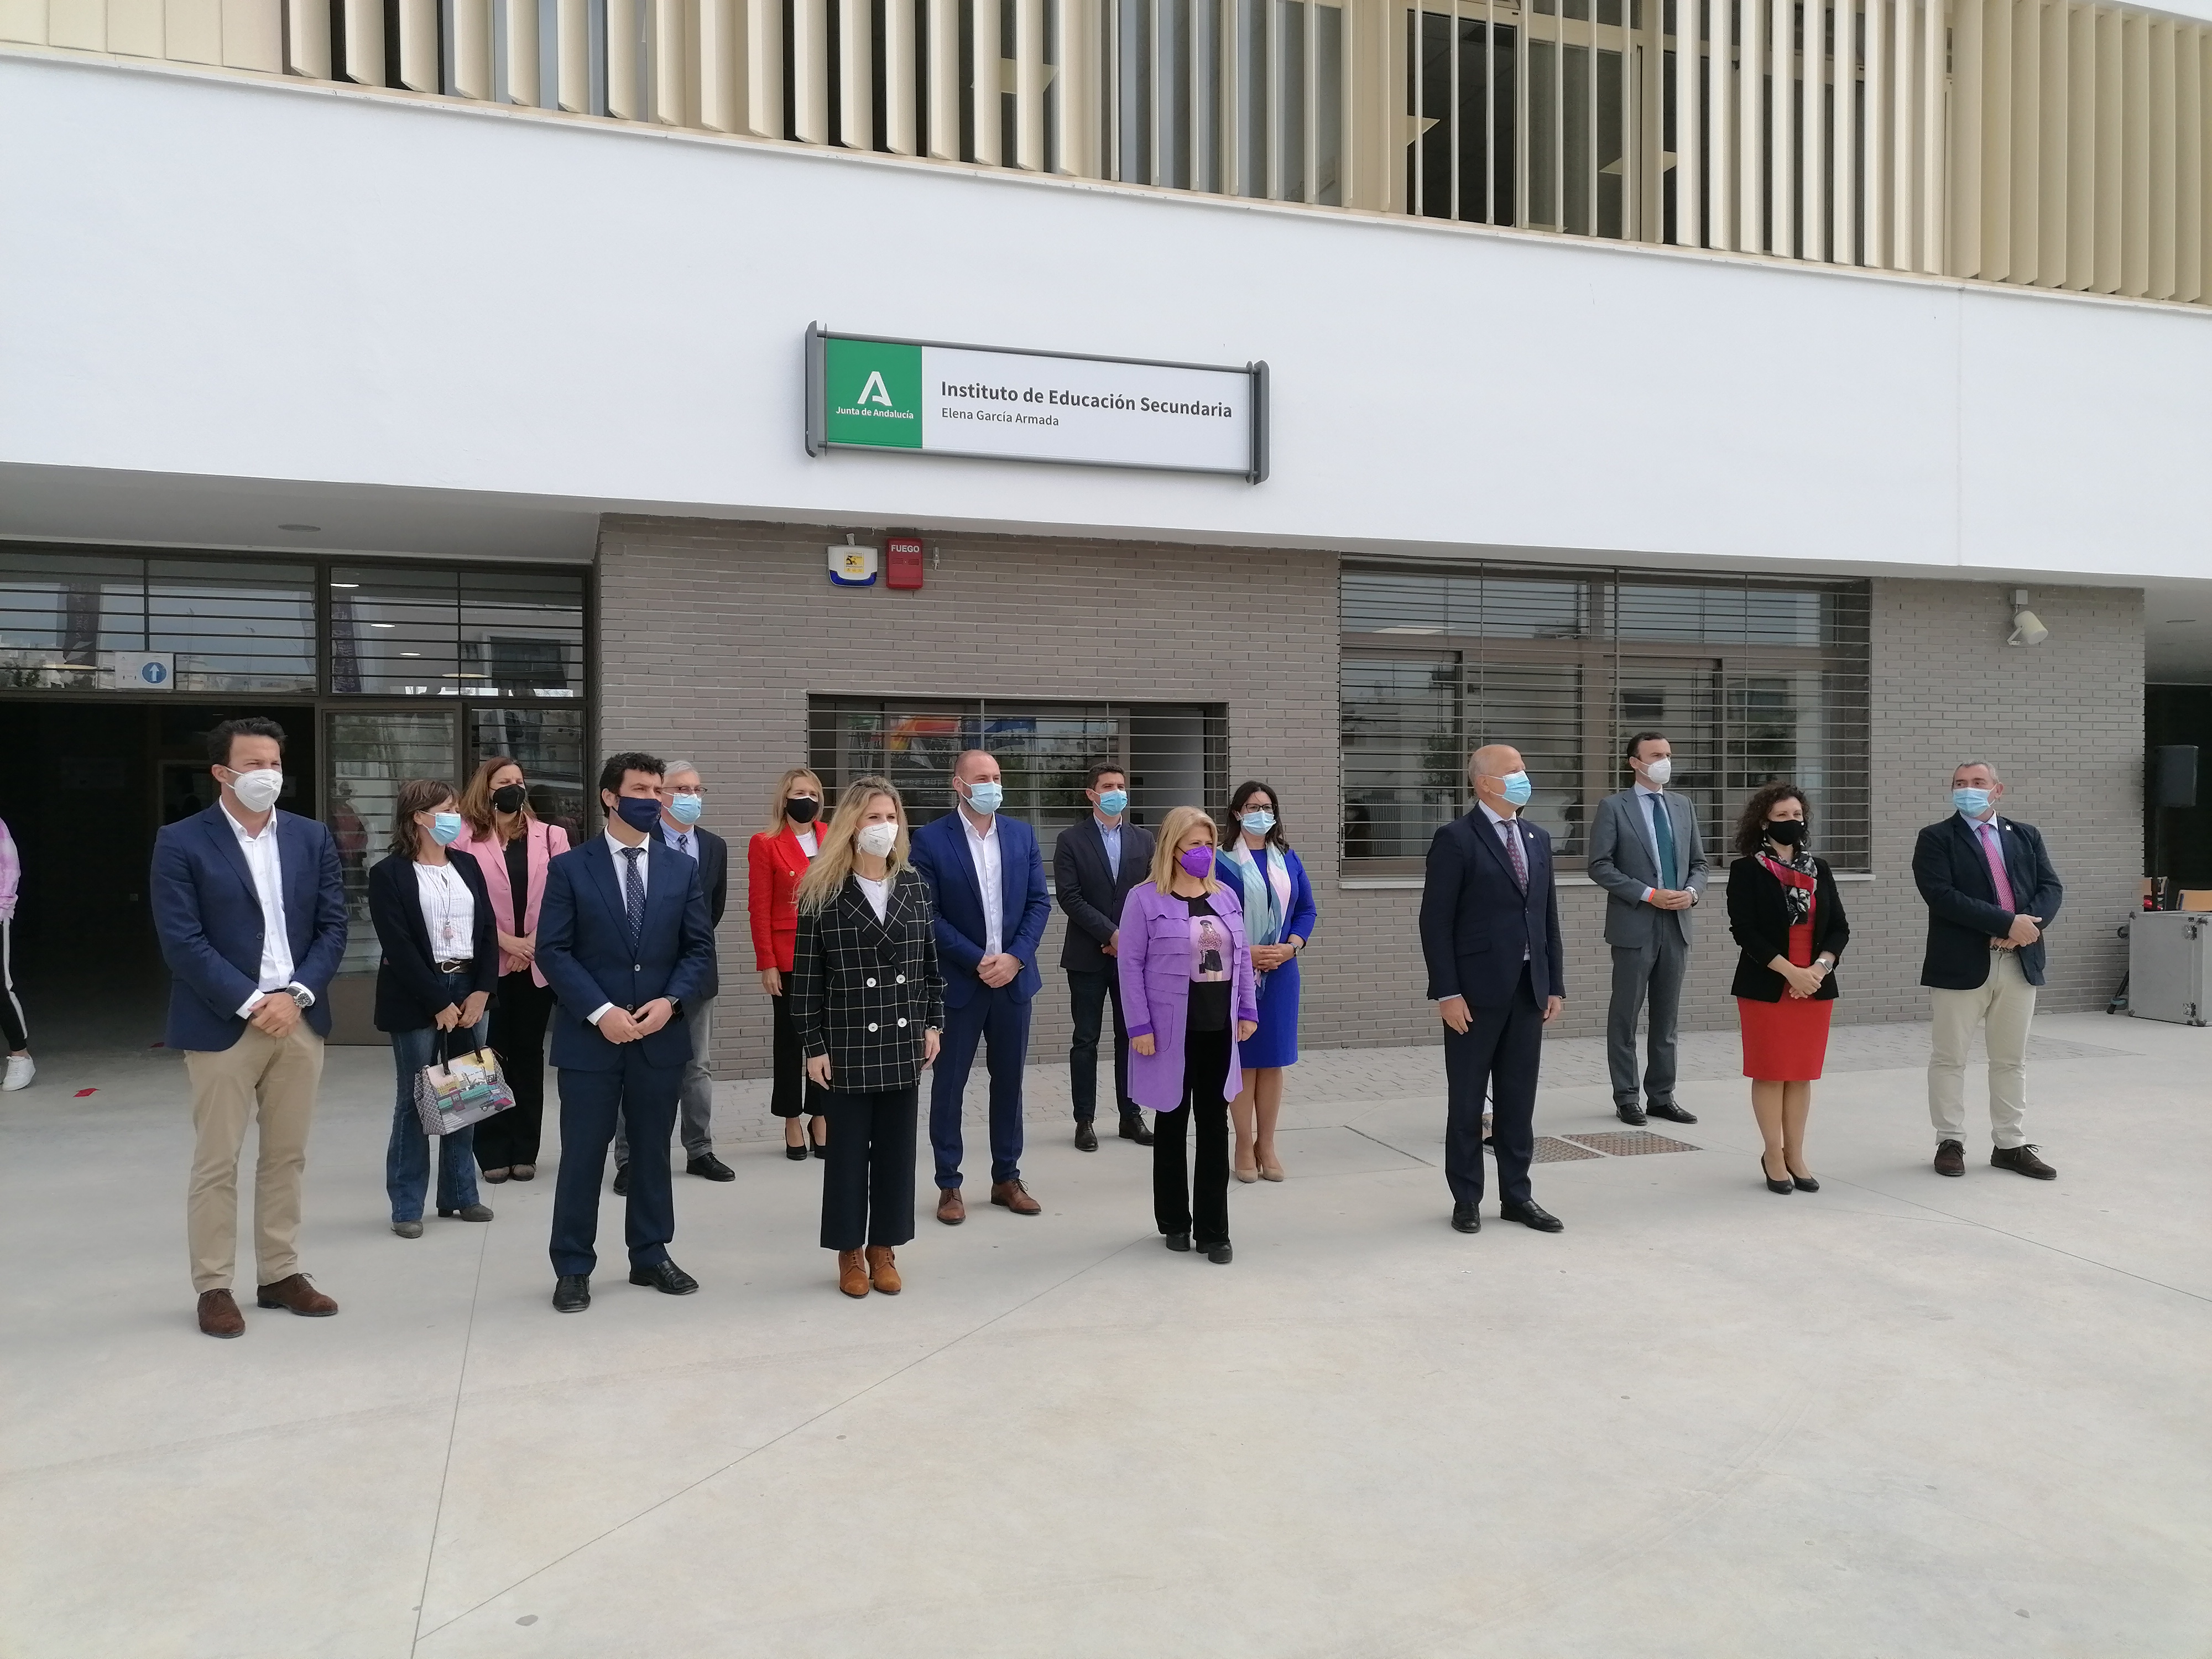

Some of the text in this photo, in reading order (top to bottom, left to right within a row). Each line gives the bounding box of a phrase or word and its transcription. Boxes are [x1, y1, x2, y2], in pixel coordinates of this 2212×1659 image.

[942, 382, 1232, 417] Instituto de Educación Secundaria
[836, 406, 859, 415] Junta
[873, 409, 914, 419] Andalucía
[942, 408, 1059, 426] Elena García Armada
[891, 545, 920, 553] FUEGO
